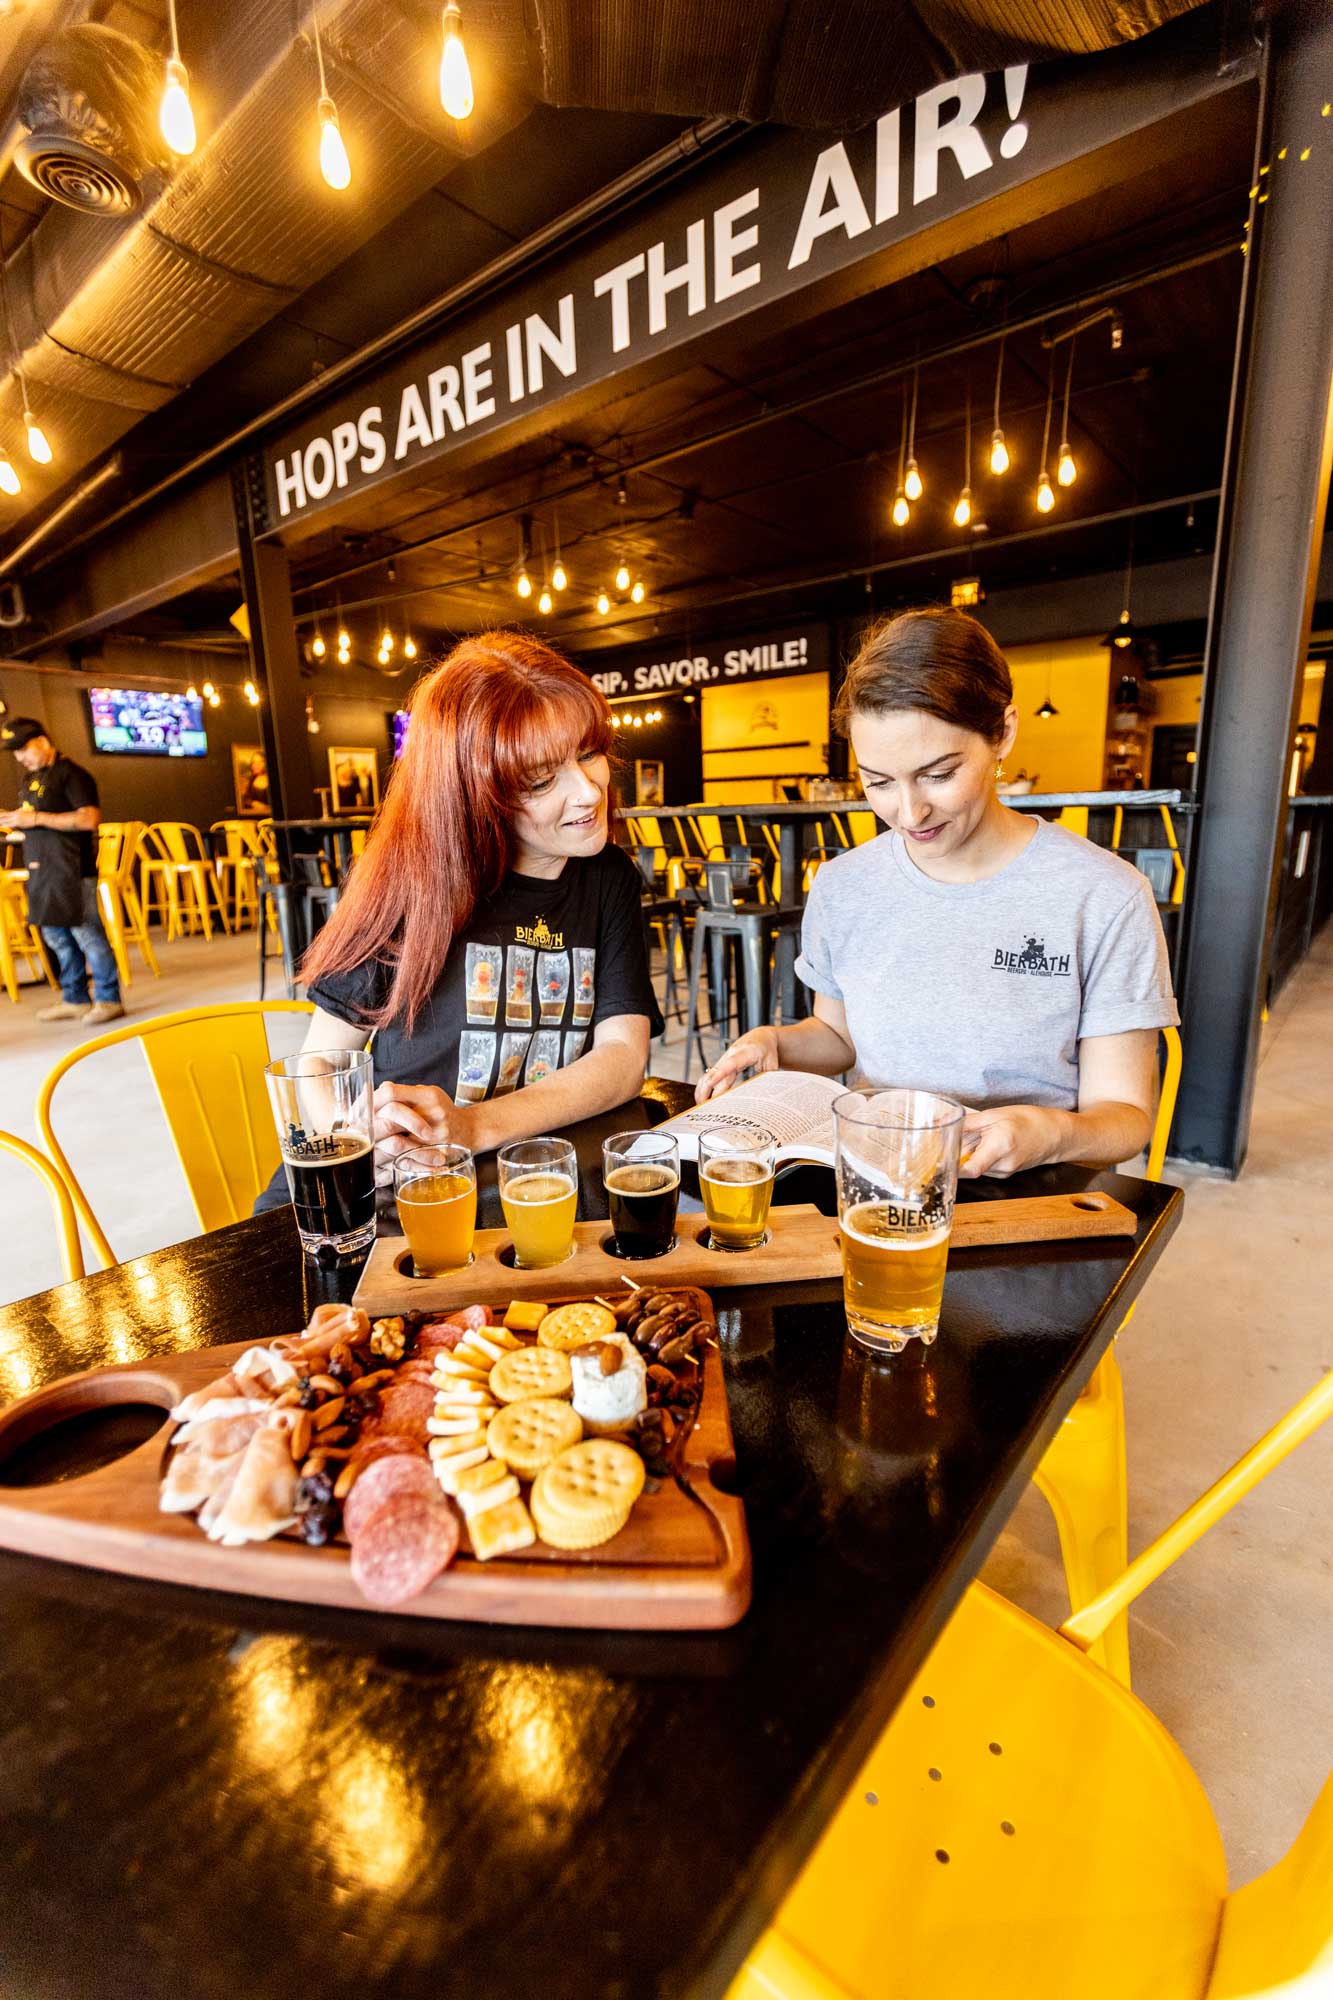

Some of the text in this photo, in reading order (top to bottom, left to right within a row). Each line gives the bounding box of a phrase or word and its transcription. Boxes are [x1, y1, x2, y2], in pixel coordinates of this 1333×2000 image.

[275, 63, 1028, 516] HOPS ARE IN THE AIR!
[591, 637, 808, 694] SIP, SAVOR, SMILE!
[994, 948, 1070, 972] BIERBATH
